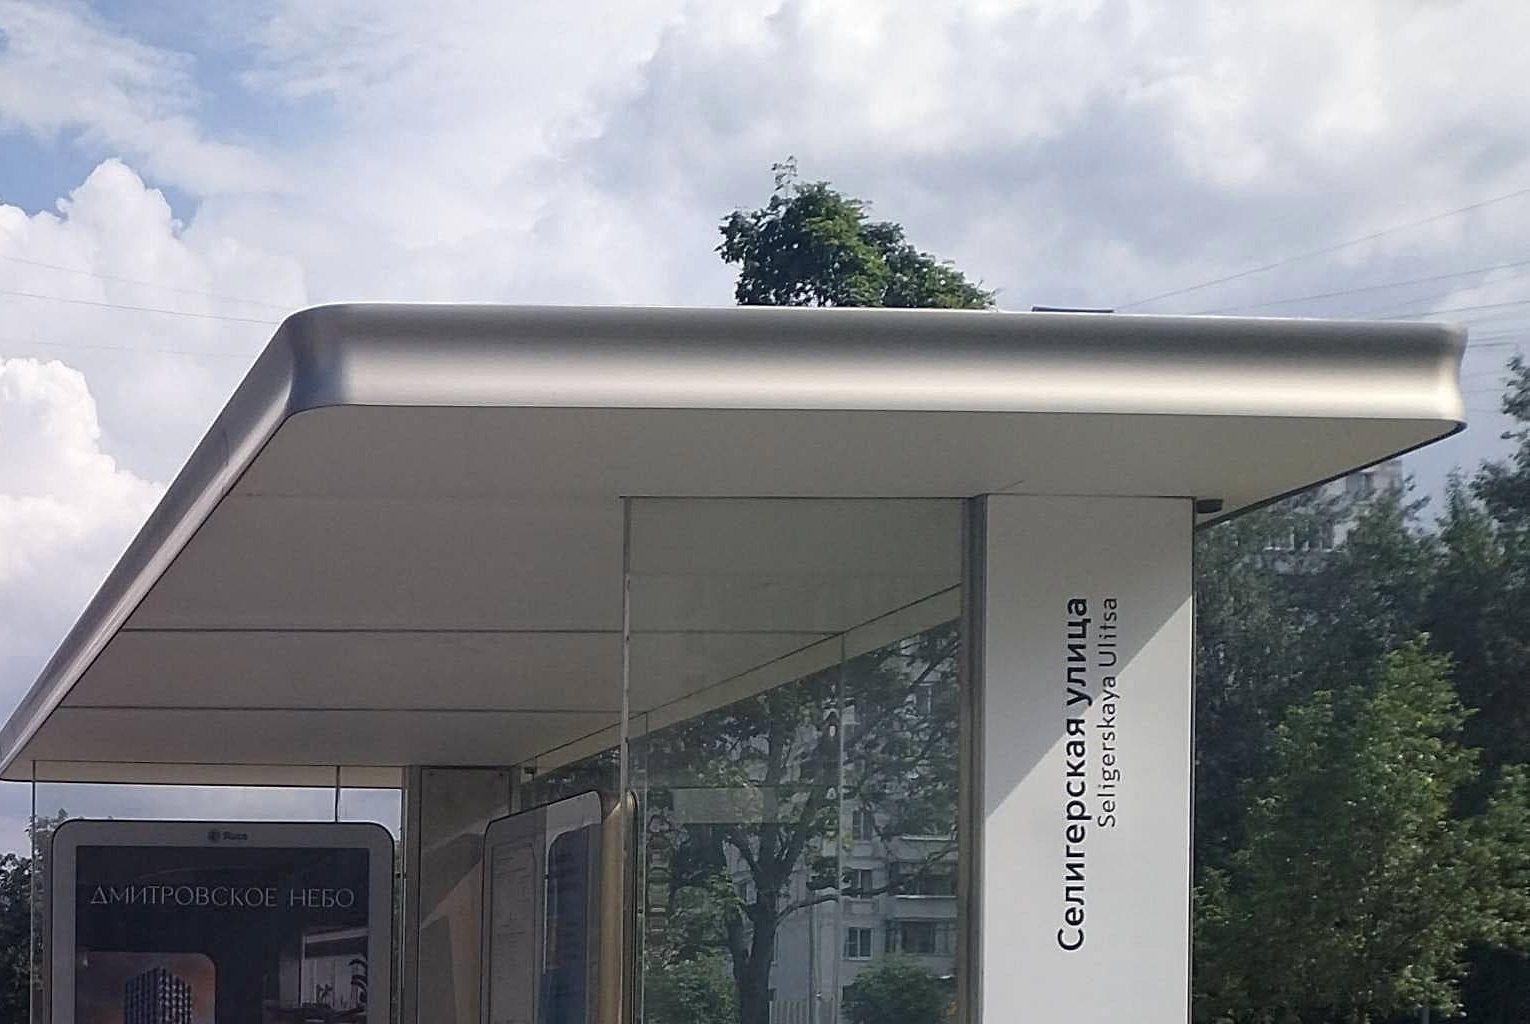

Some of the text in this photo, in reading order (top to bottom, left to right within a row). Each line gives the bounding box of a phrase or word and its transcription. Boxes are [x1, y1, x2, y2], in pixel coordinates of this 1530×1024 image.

[1058, 597, 1093, 951] Селигерская улица
[1097, 597, 1120, 828] Seligerskaya Ulitsa
[90, 885, 355, 908] ДМИТРОВСКОЕ НЕБО
